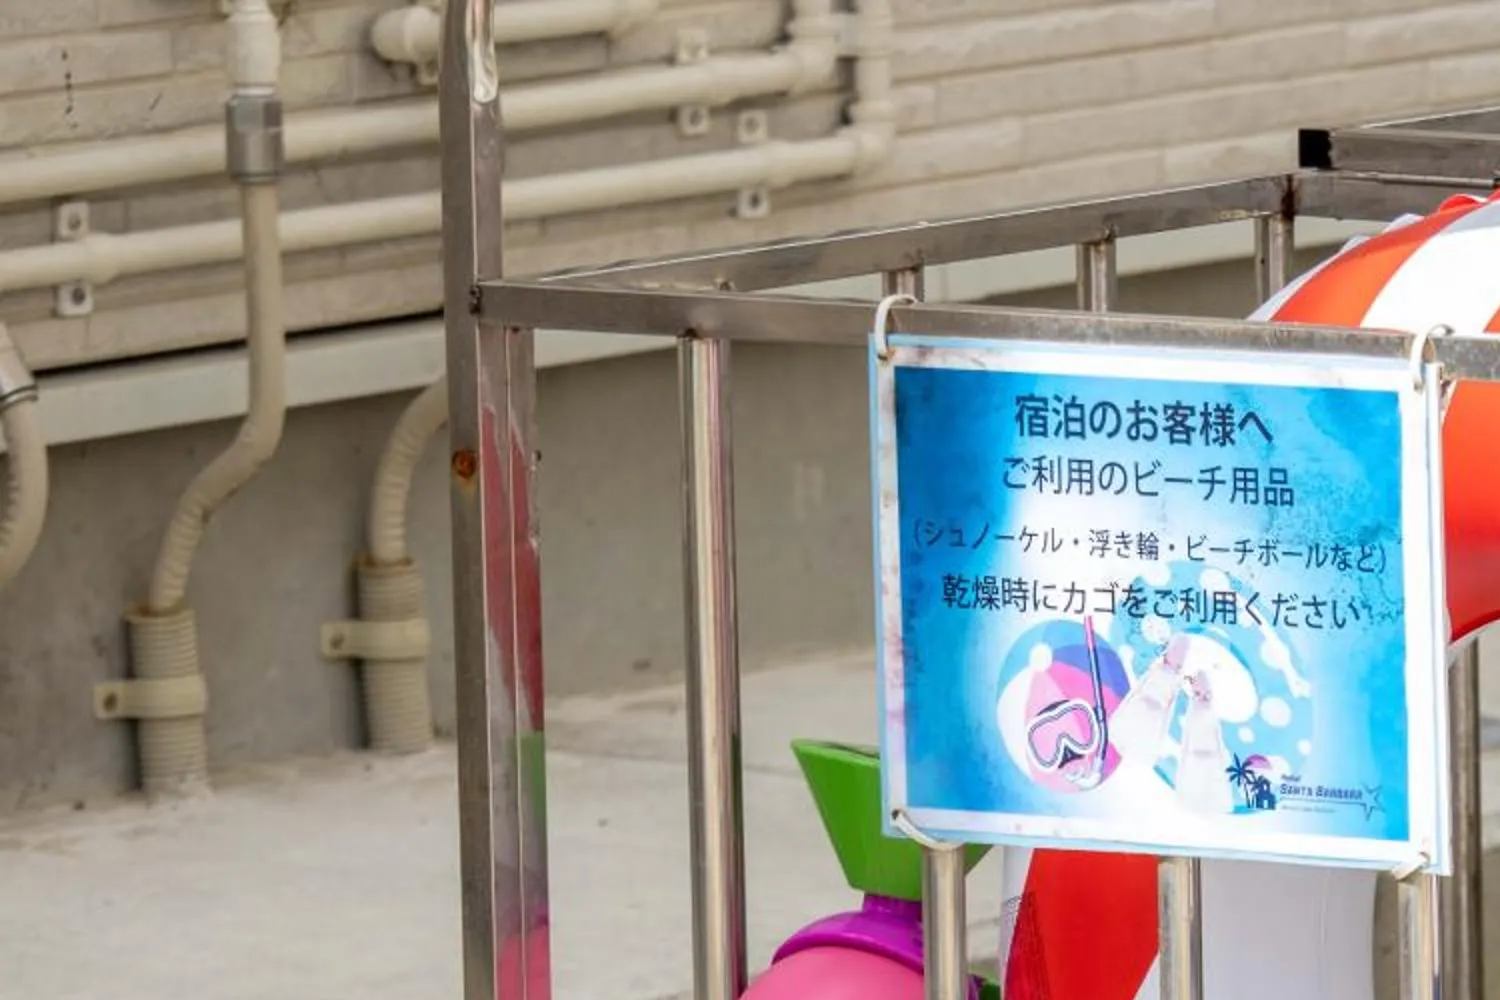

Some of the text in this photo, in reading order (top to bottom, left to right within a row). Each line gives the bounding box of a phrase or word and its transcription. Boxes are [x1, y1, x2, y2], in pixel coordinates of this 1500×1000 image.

[1014, 394, 1274, 448] 宿泊のお客様へ
[1002, 454, 1295, 508] ご利用のビーチ用品
[941, 573, 1361, 630] 乾燥時にカゴをご利用ください
